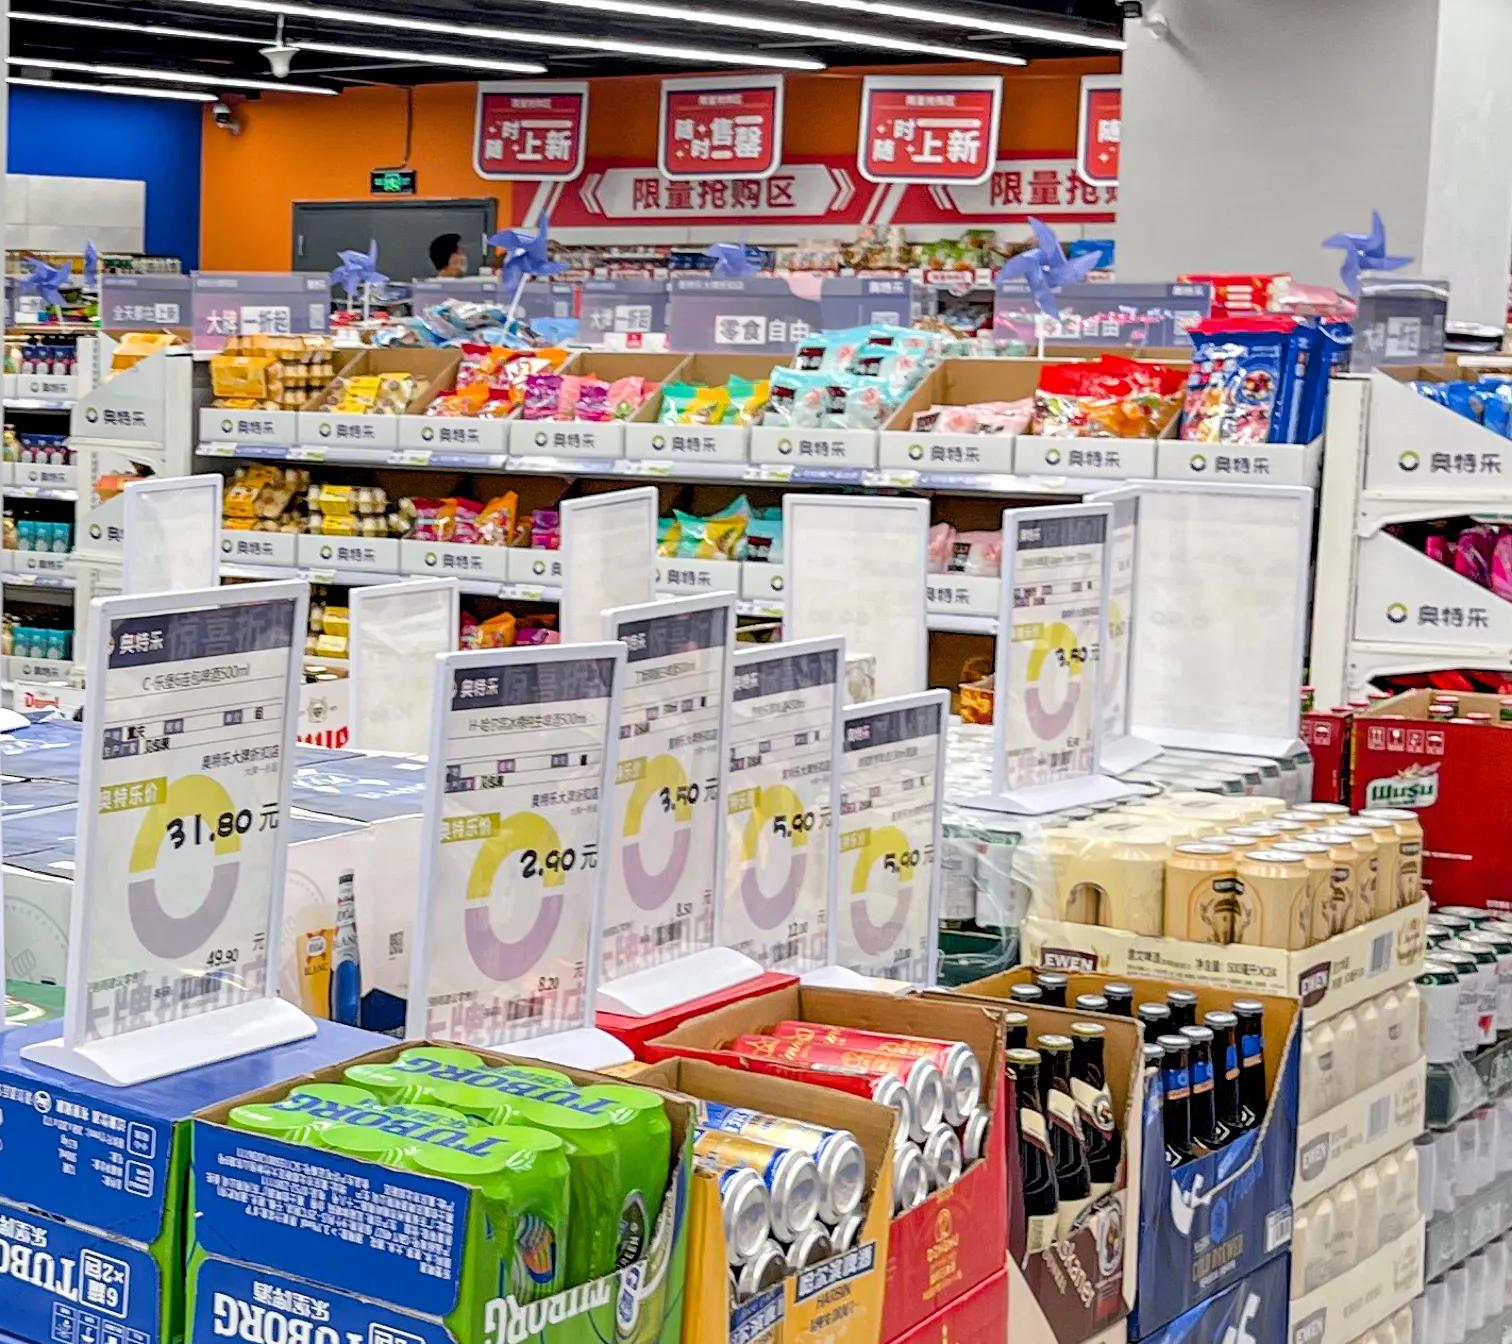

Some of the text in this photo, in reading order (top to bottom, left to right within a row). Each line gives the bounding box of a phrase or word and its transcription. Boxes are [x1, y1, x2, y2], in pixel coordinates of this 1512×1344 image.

[633, 176, 796, 209] 限量抢购区
[931, 445, 980, 463] 奥特乐
[1069, 449, 1120, 469] 奥特乐
[1214, 456, 1269, 475] 奥特乐
[1430, 452, 1501, 474] 奥特乐
[1416, 605, 1489, 628] 奥特乐
[119, 631, 164, 654] 奥特乐
[167, 802, 280, 849] 31.80 元
[521, 844, 598, 878] 2.90 元
[1045, 955, 1094, 972] EWEN
[393, 1057, 620, 1116] TUBORG
[270, 1092, 508, 1158] TUBORG
